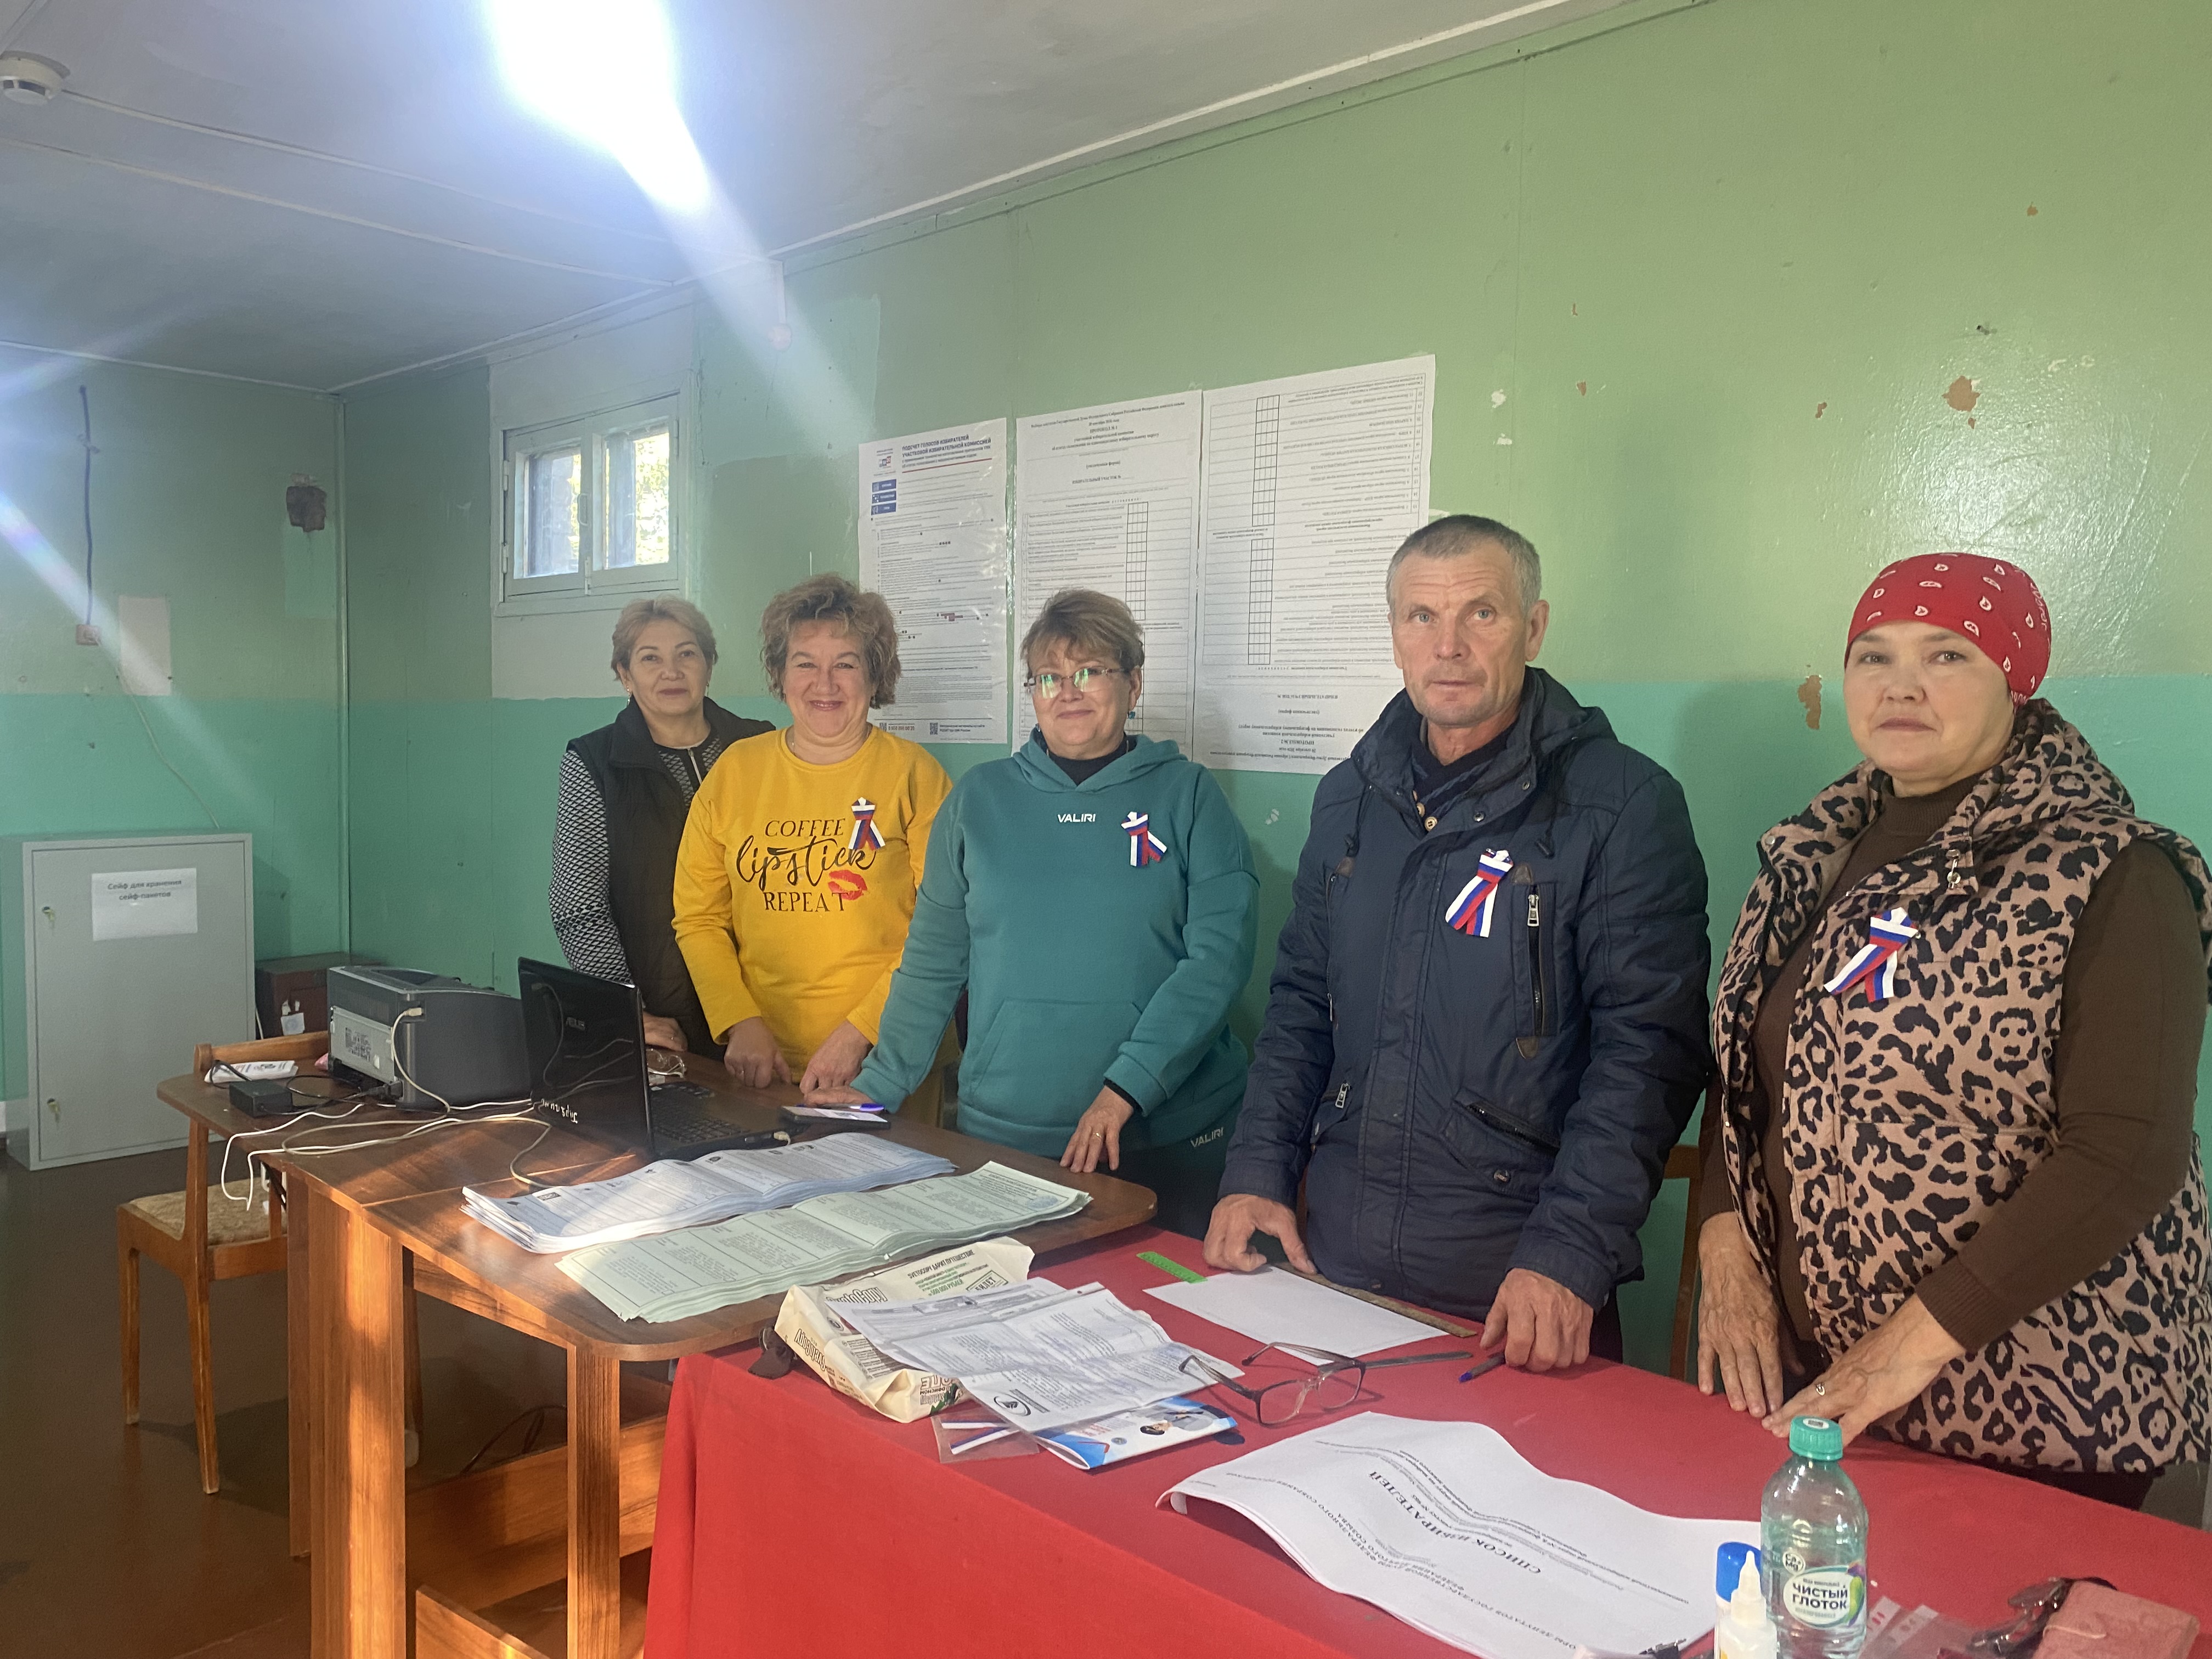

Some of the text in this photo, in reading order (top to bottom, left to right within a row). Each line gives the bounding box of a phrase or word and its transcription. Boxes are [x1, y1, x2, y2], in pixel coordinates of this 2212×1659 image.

[902, 437, 991, 458] УЧАСТКОВОЙ ИЗБИРАТЕЛЬНОЙ КОМИССИЕЙ
[921, 440, 939, 448] ГОЛОСОВ
[939, 434, 969, 444] ИЗБИРАТЕЛЕЙ
[765, 817, 846, 837] COFFEE
[1057, 813, 1096, 823] VALIRI
[736, 834, 877, 892] lipstick
[108, 882, 128, 890] Сейф
[145, 879, 182, 888] хранения
[119, 891, 171, 900] сейф-пакетов
[763, 891, 848, 912] REPEAT
[1190, 1127, 1223, 1148] VALIRI
[932, 1260, 946, 1271] ДАРИТ
[945, 1249, 975, 1265] ПУТЕШЕСТВИЕ
[794, 1328, 826, 1372] SvetoCopy
[1369, 1471, 1470, 1541] ИЗБИРАТЕЛЕЙ
[1318, 1503, 1376, 1561] ФЕДЕРАЛЬНОГО
[1337, 1513, 1367, 1544] СОЗЫВА
[1475, 1538, 1541, 1573] СПИСОК
[1792, 1582, 1848, 1599] ЧИСТЫЙ
[1792, 1593, 1847, 1610] ГЛОТОК
